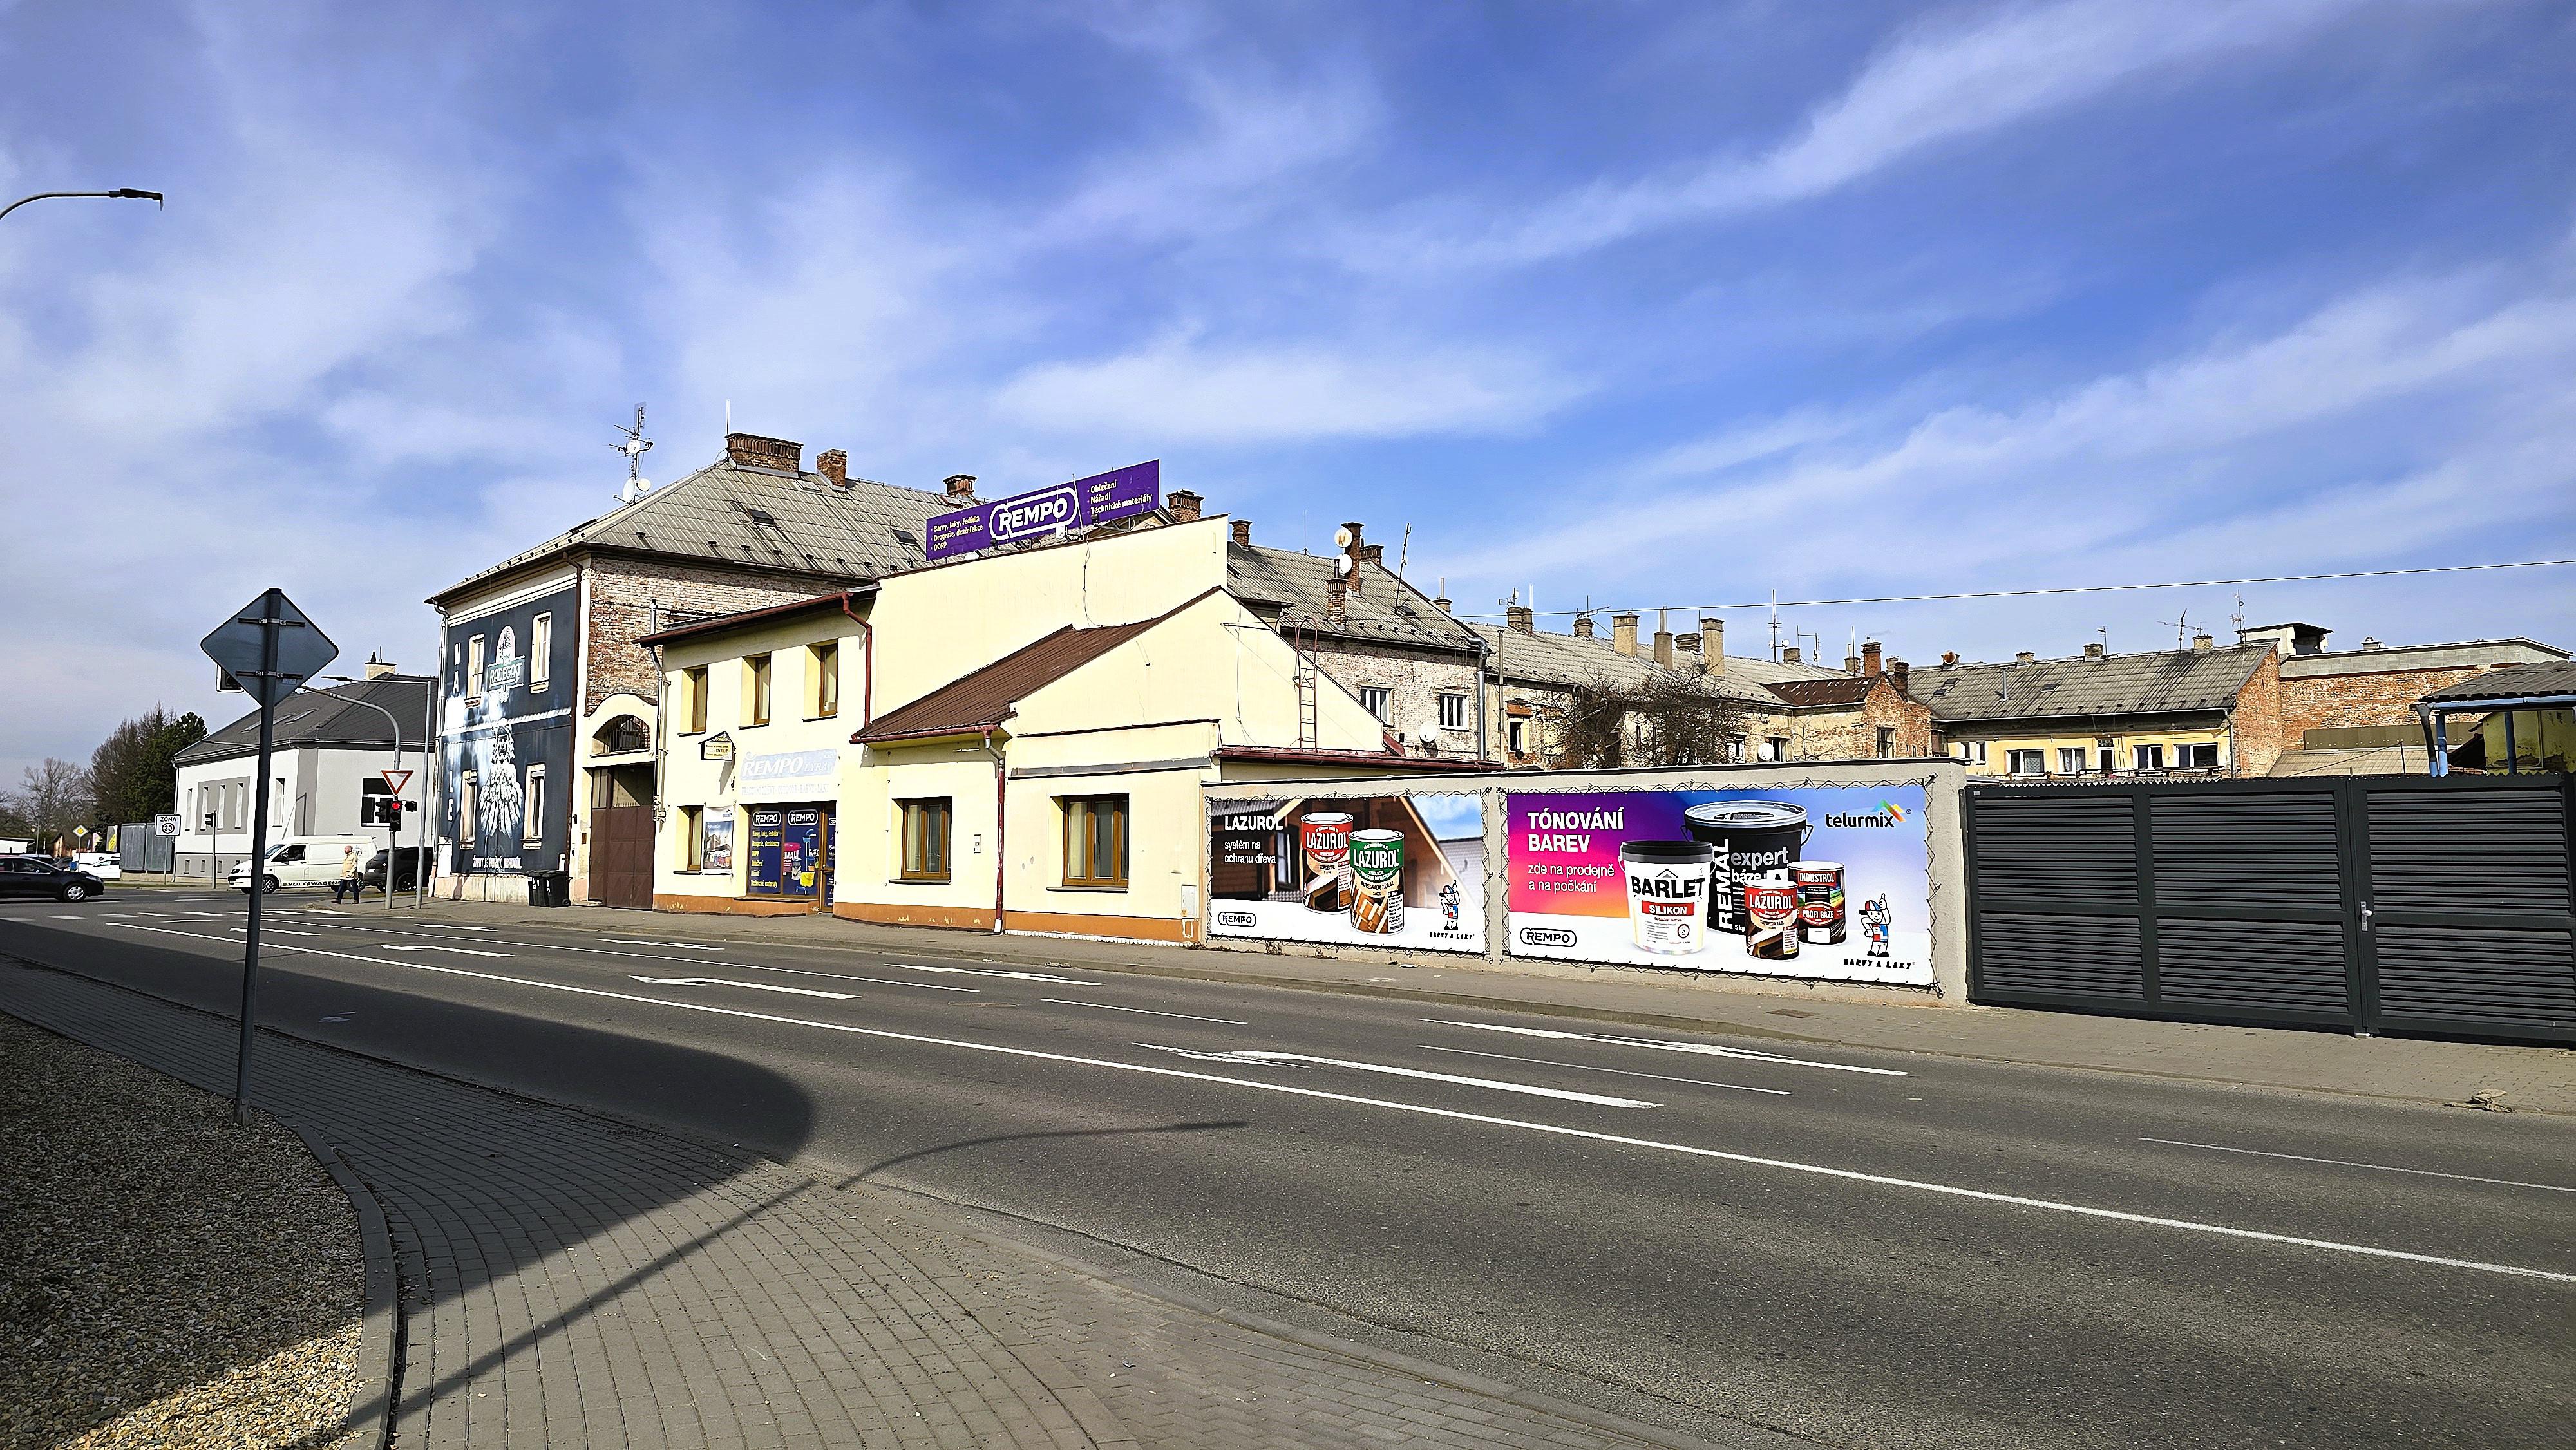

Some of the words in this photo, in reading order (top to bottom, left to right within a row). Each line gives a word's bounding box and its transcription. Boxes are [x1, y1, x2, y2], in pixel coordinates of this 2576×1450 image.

[1090, 478, 1117, 493] Oblečení
[1090, 492, 1111, 504] Nářadí
[1090, 500, 1121, 514] Technické
[1122, 493, 1153, 507] materiály
[999, 498, 1068, 532] REMPO
[489, 662, 522, 684] RADEGAST
[741, 757, 804, 777] REMPO
[755, 814, 778, 823] REMPO
[791, 813, 815, 824] REMPO
[1224, 815, 1283, 831] LAZUROL
[1527, 807, 1624, 830] TÓNOVÁNÍ
[1826, 811, 1894, 827] telurmix
[1224, 840, 1250, 852] systém
[1306, 831, 1349, 850] LAZUROL
[1528, 834, 1591, 852] BAREV
[1224, 854, 1254, 863] ochranu
[1255, 853, 1276, 864] dřeva
[1354, 849, 1399, 869] LAZUROL
[1730, 846, 1789, 871] expert
[1528, 863, 1548, 874] zde
[1550, 865, 1564, 875] na
[1566, 863, 1615, 879] prodejně
[1731, 869, 1762, 883] báze
[1799, 872, 1835, 883] INDUSTROL
[1528, 881, 1535, 890] a
[1538, 881, 1551, 891] na
[1553, 879, 1597, 894] počkání
[1631, 875, 1705, 898] BARLET
[1714, 838, 1733, 930] REMAL
[1649, 905, 1687, 915] SILIKON
[1749, 894, 1794, 910] LAZUROL
[1222, 915, 1253, 924] REMPO
[1803, 909, 1819, 919] PROFI
[1820, 909, 1834, 919] BÁZE
[1526, 931, 1571, 943] REMPO
[1843, 958, 1873, 967] BARVY
[1886, 961, 1912, 970] LAKY
